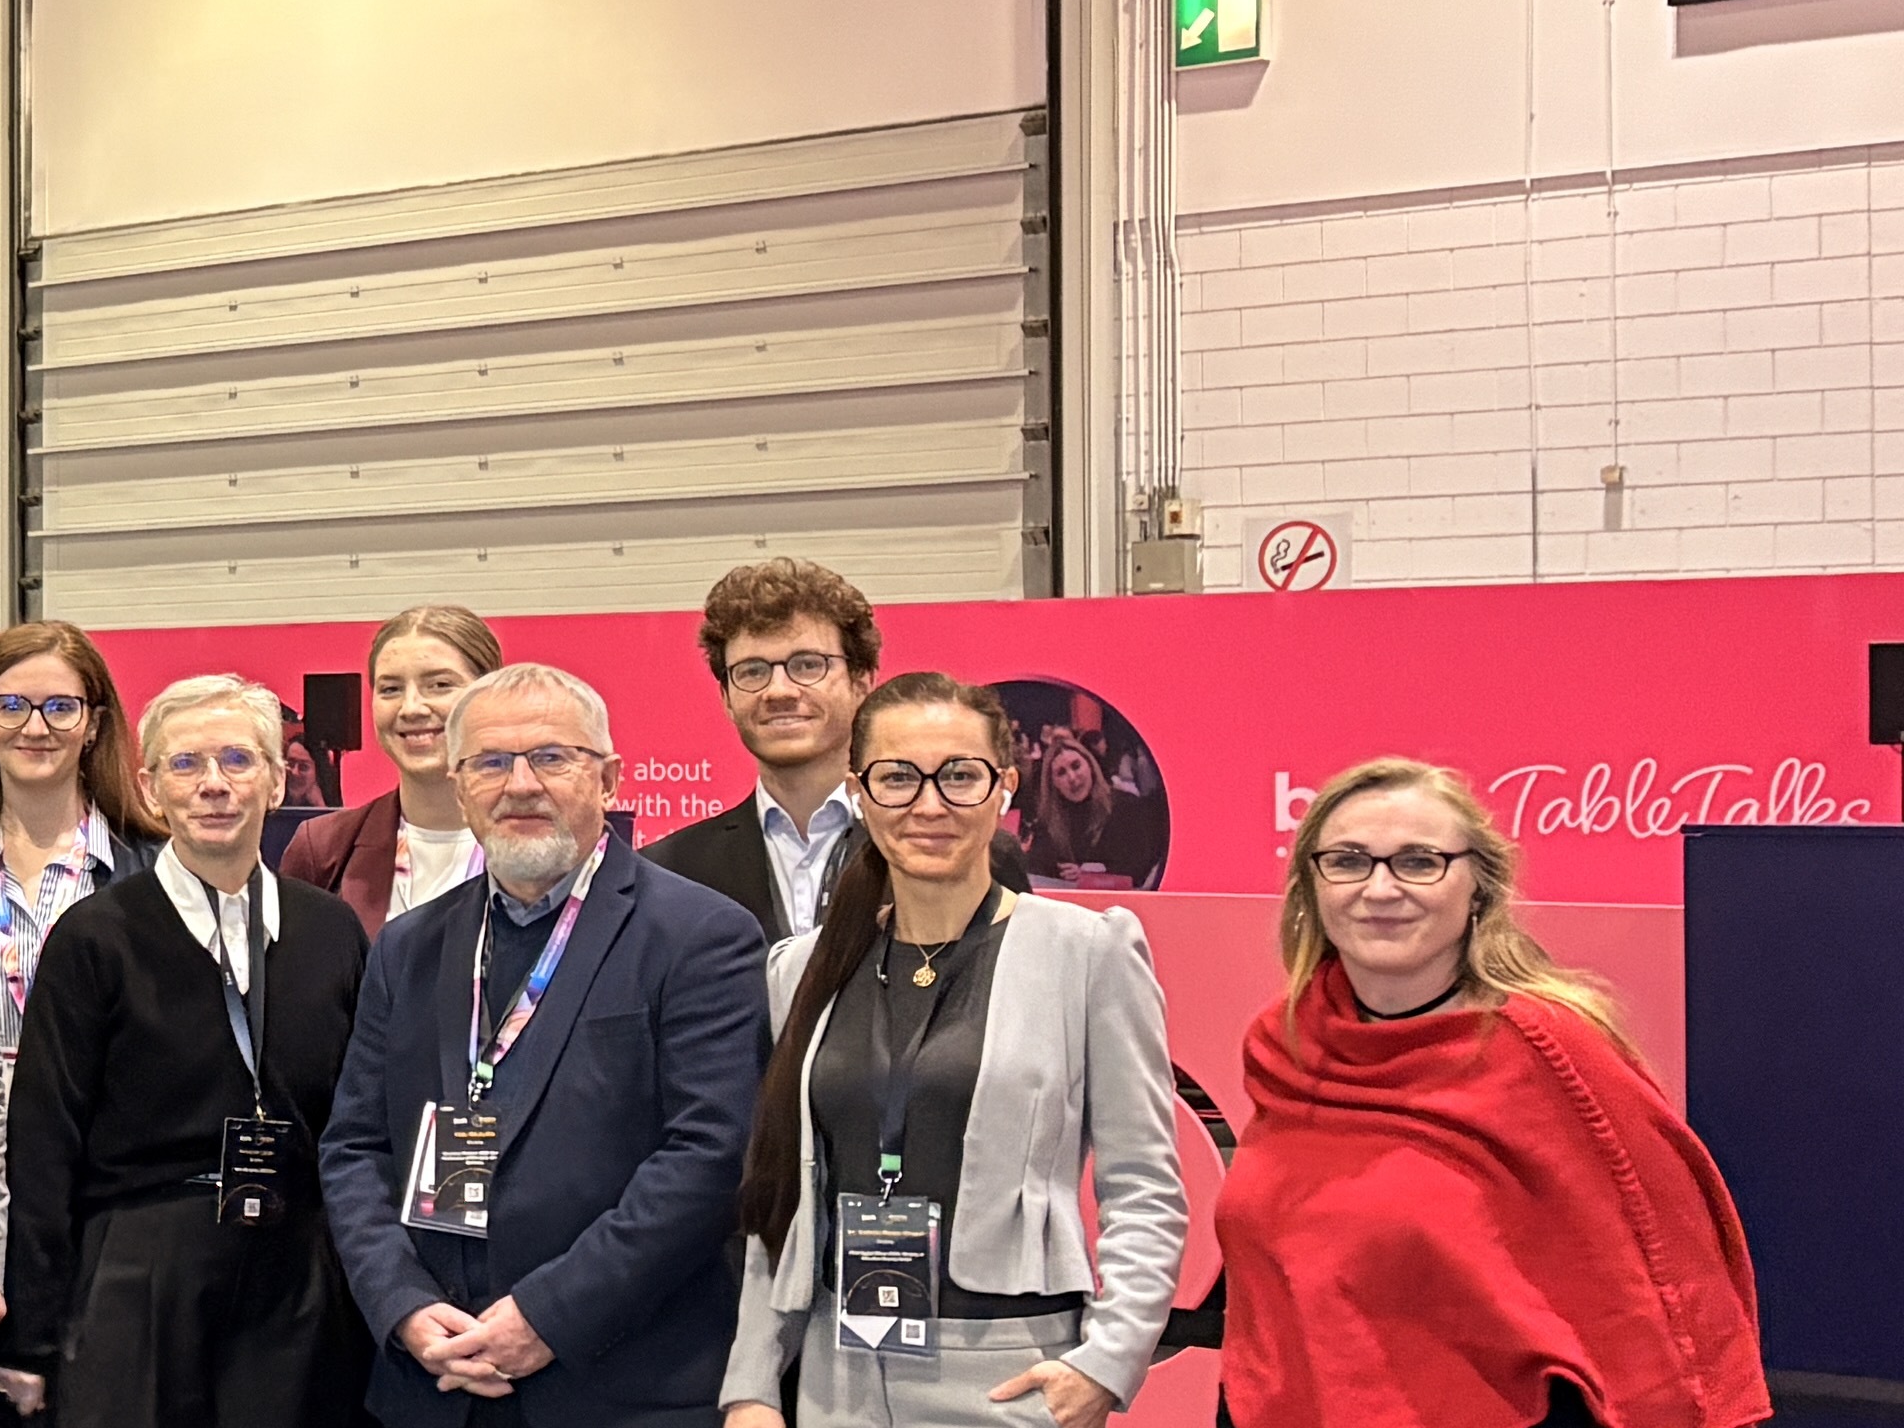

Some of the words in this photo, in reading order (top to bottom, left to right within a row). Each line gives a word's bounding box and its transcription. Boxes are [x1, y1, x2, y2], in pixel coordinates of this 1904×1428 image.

[633, 756, 712, 782] about
[615, 792, 671, 817] with
[680, 793, 724, 818] the
